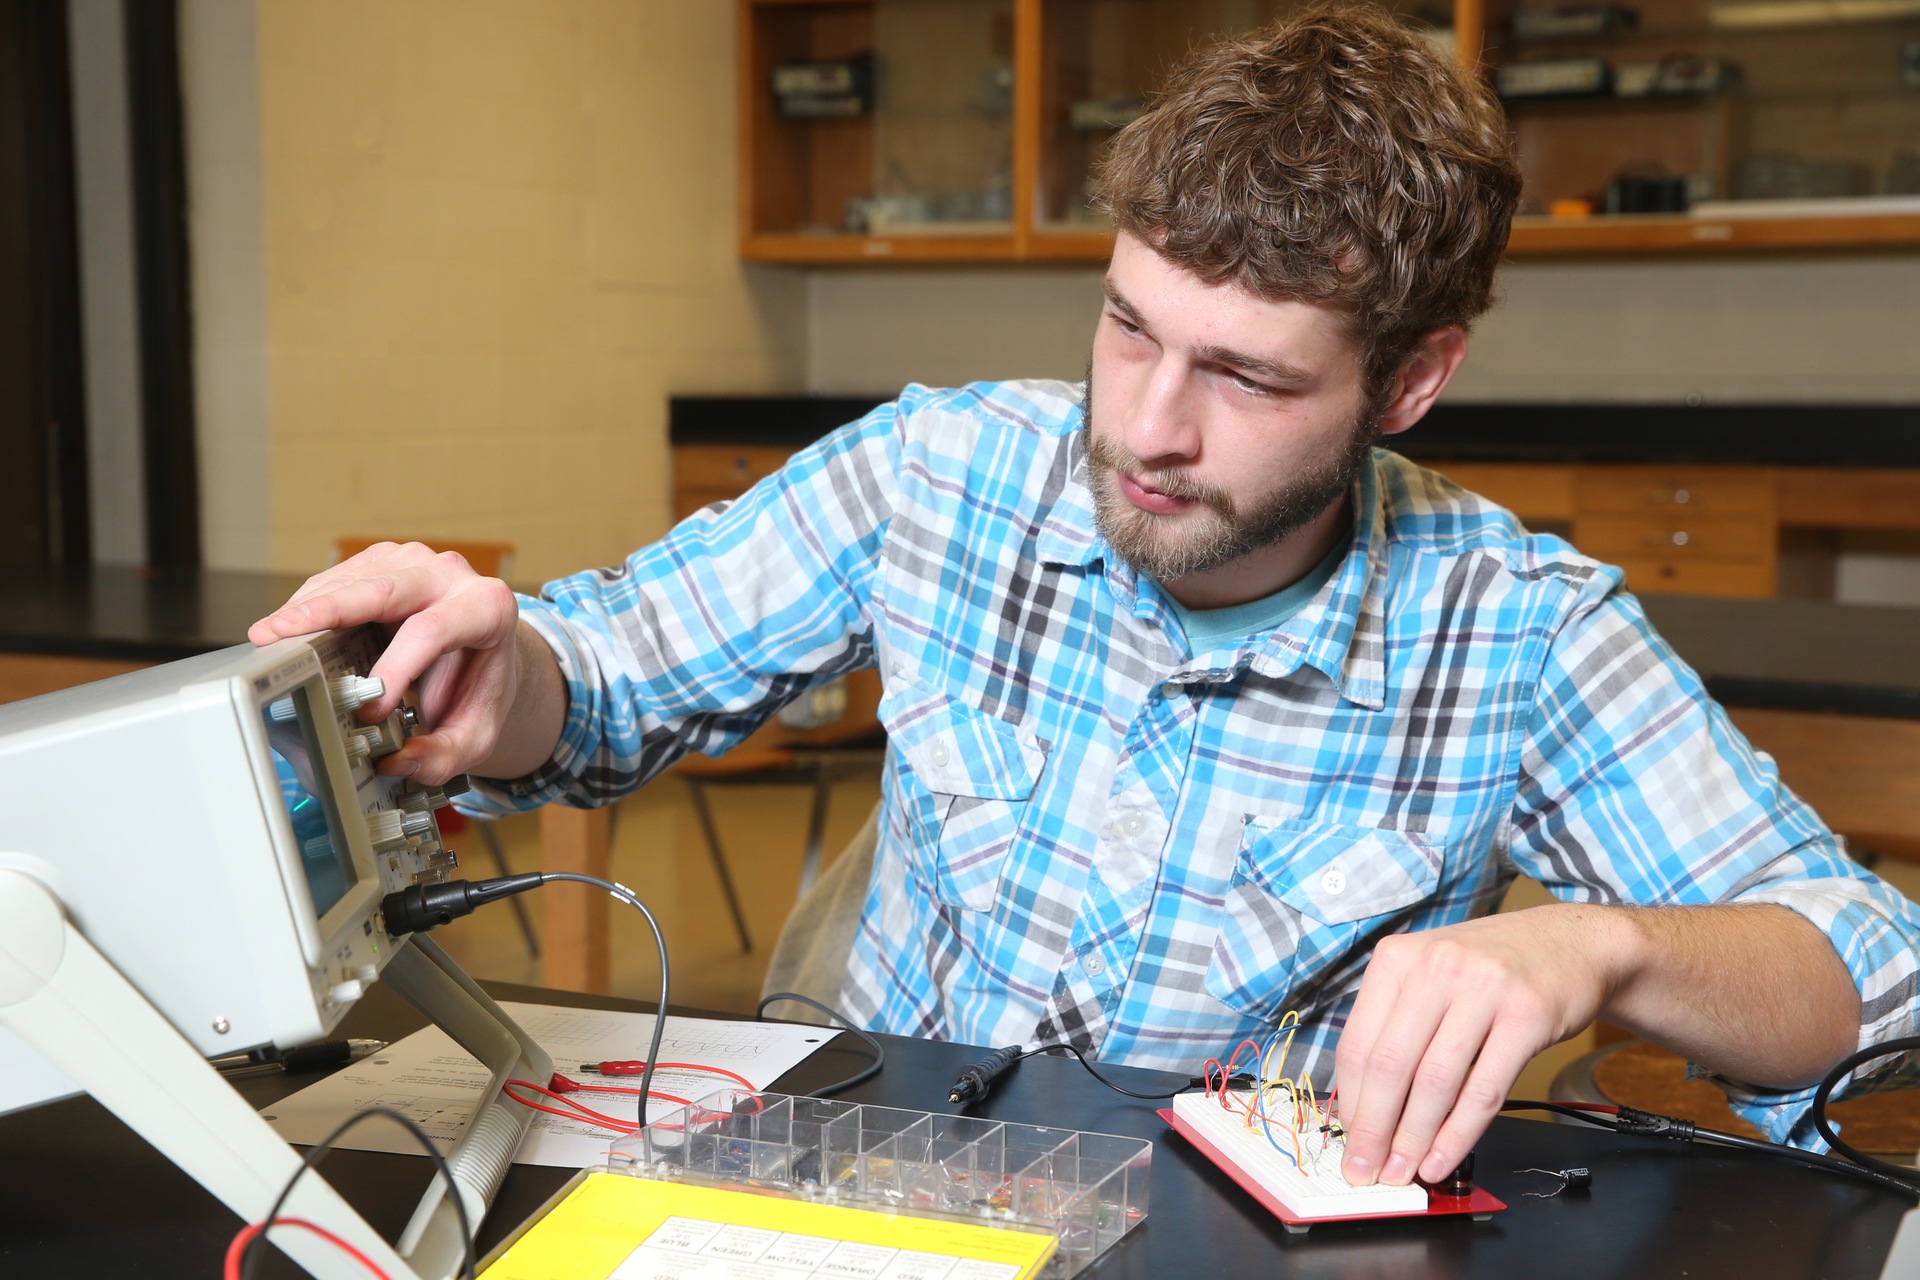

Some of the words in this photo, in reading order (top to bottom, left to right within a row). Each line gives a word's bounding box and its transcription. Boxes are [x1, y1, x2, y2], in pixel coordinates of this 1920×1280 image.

[659, 1238, 690, 1248] BLUE
[711, 1246, 753, 1257] GREEN
[766, 1254, 814, 1267] YELLOW
[825, 1263, 876, 1275] ORANGE
